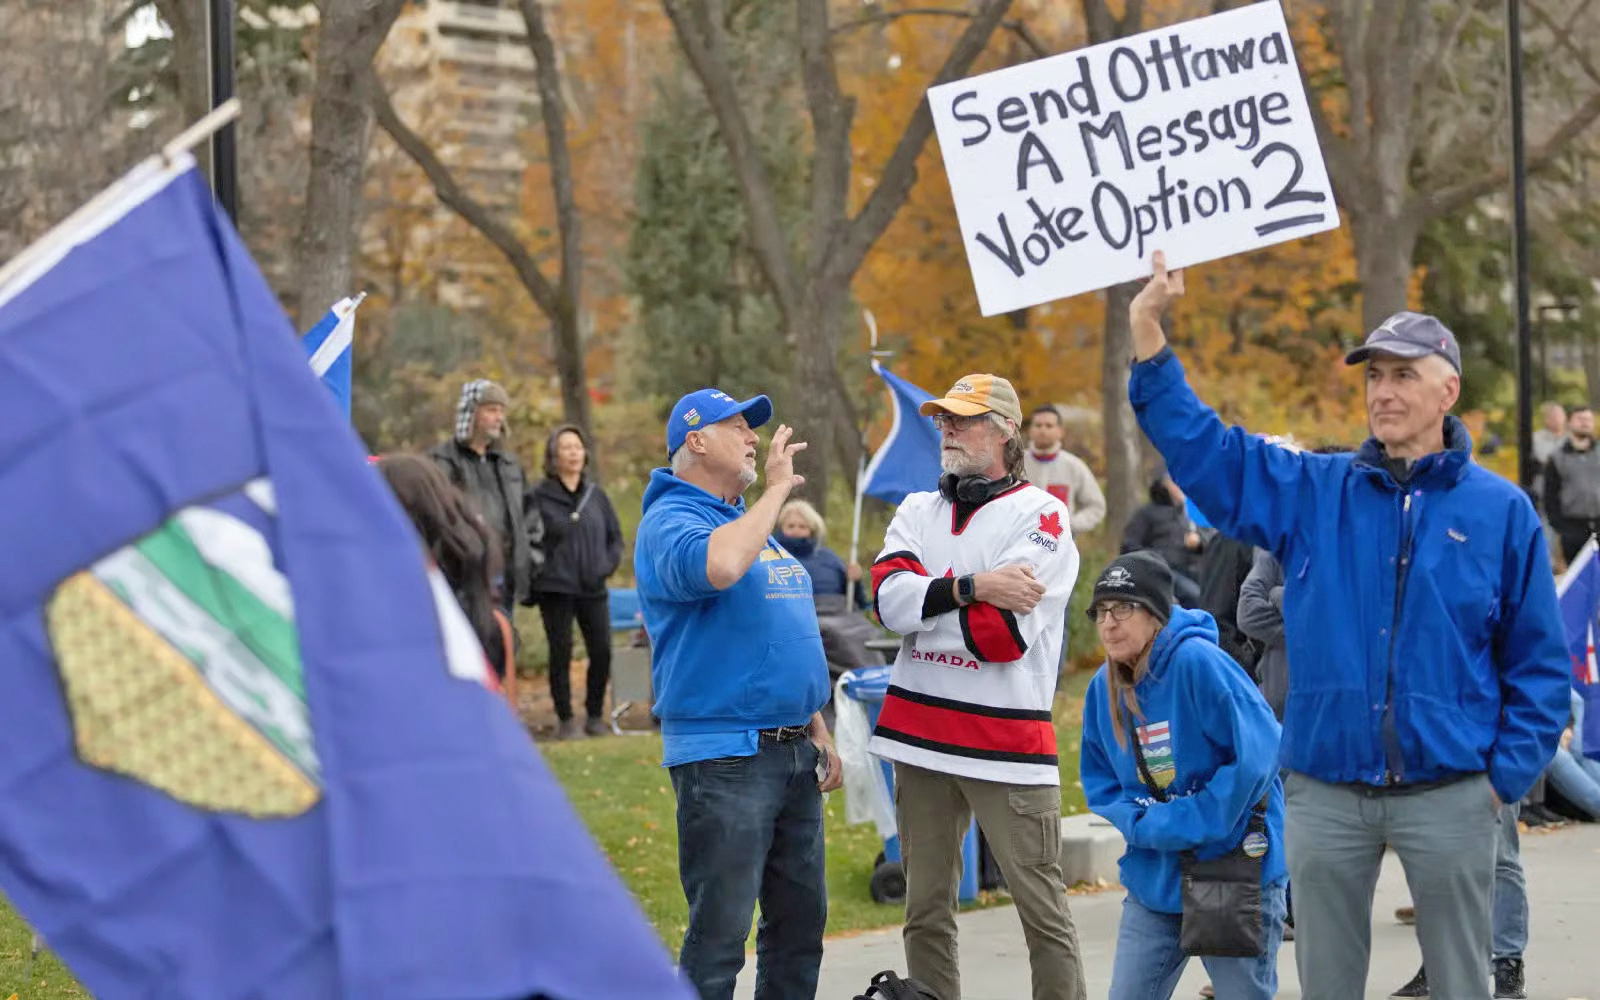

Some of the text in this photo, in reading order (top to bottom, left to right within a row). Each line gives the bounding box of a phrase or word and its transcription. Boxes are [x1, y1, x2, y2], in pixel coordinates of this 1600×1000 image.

[952, 32, 1288, 147] Send Ottawa
[1017, 90, 1292, 191] A Message
[975, 142, 1326, 278] Vote Option 2
[911, 649, 979, 671] CANADA
